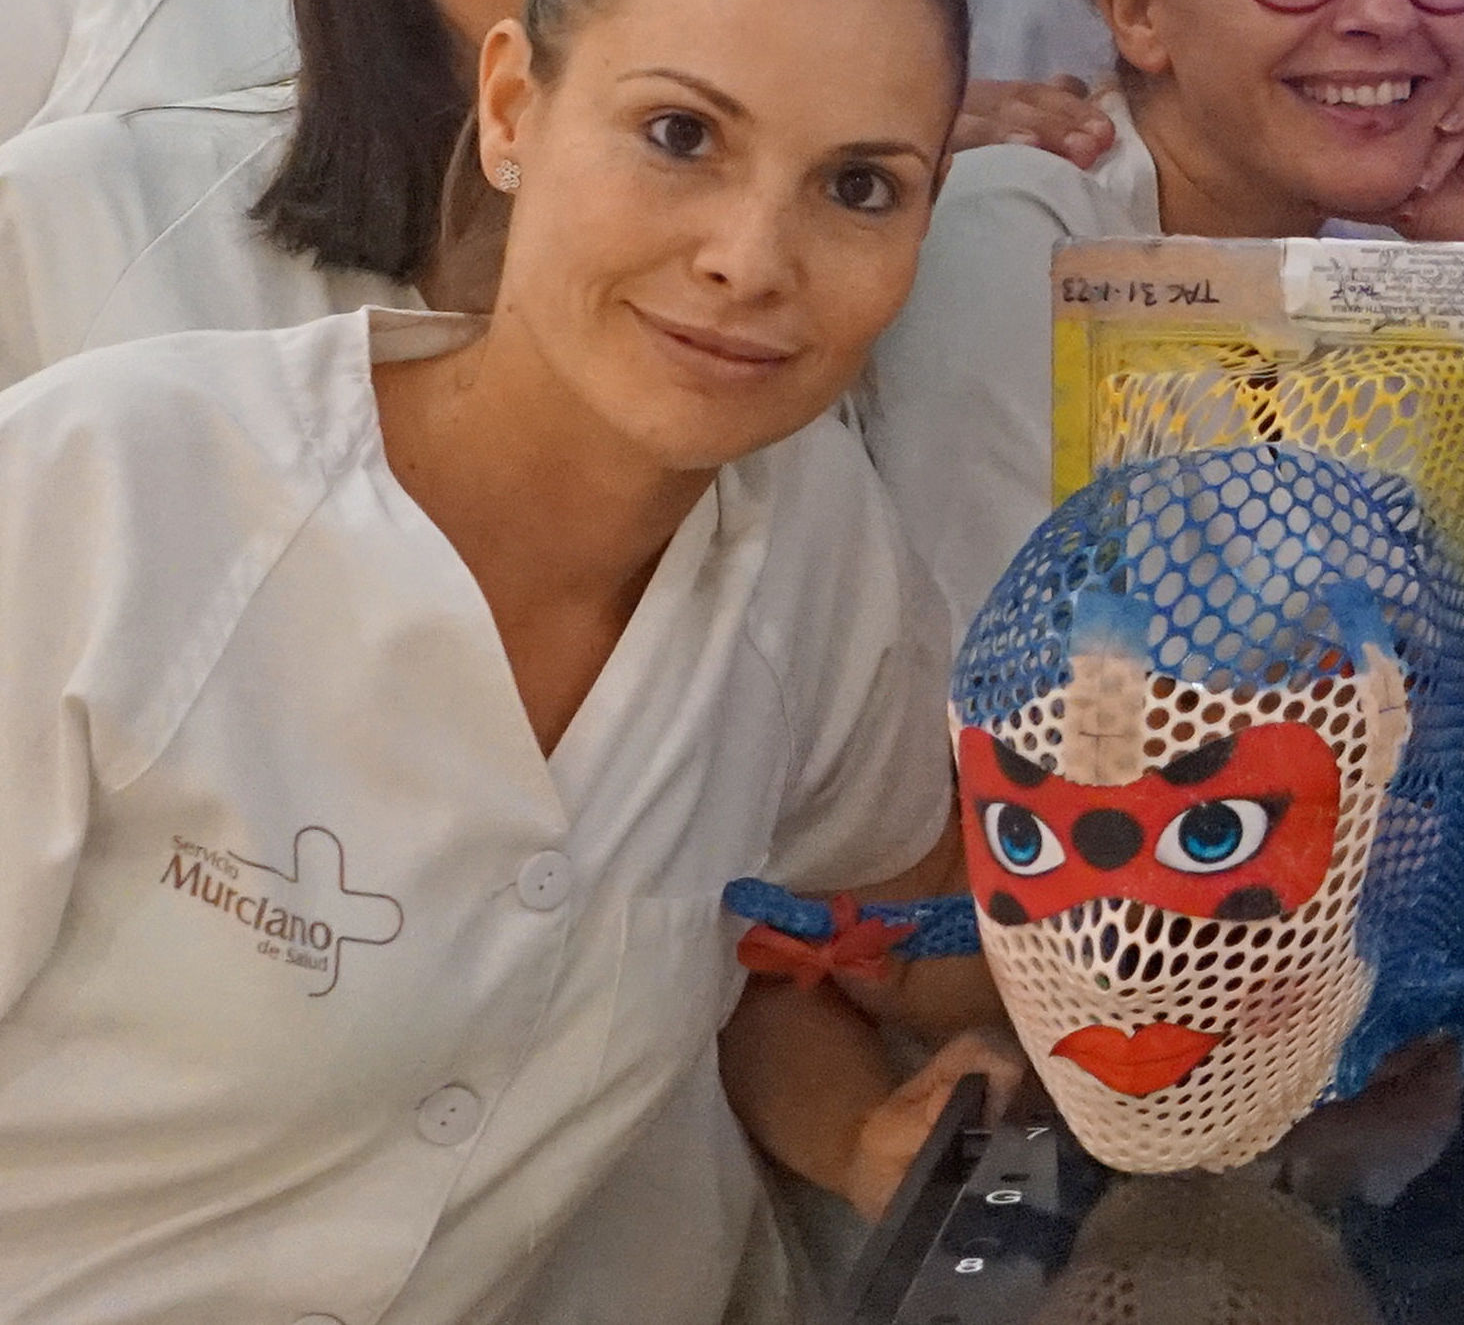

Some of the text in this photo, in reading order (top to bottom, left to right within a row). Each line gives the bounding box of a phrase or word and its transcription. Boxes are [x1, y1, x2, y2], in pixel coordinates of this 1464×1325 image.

[257, 940, 329, 972] de Salud
[1026, 1127, 1049, 1140] 7
[985, 1189, 1023, 1204] G
[954, 1257, 984, 1273] 8
